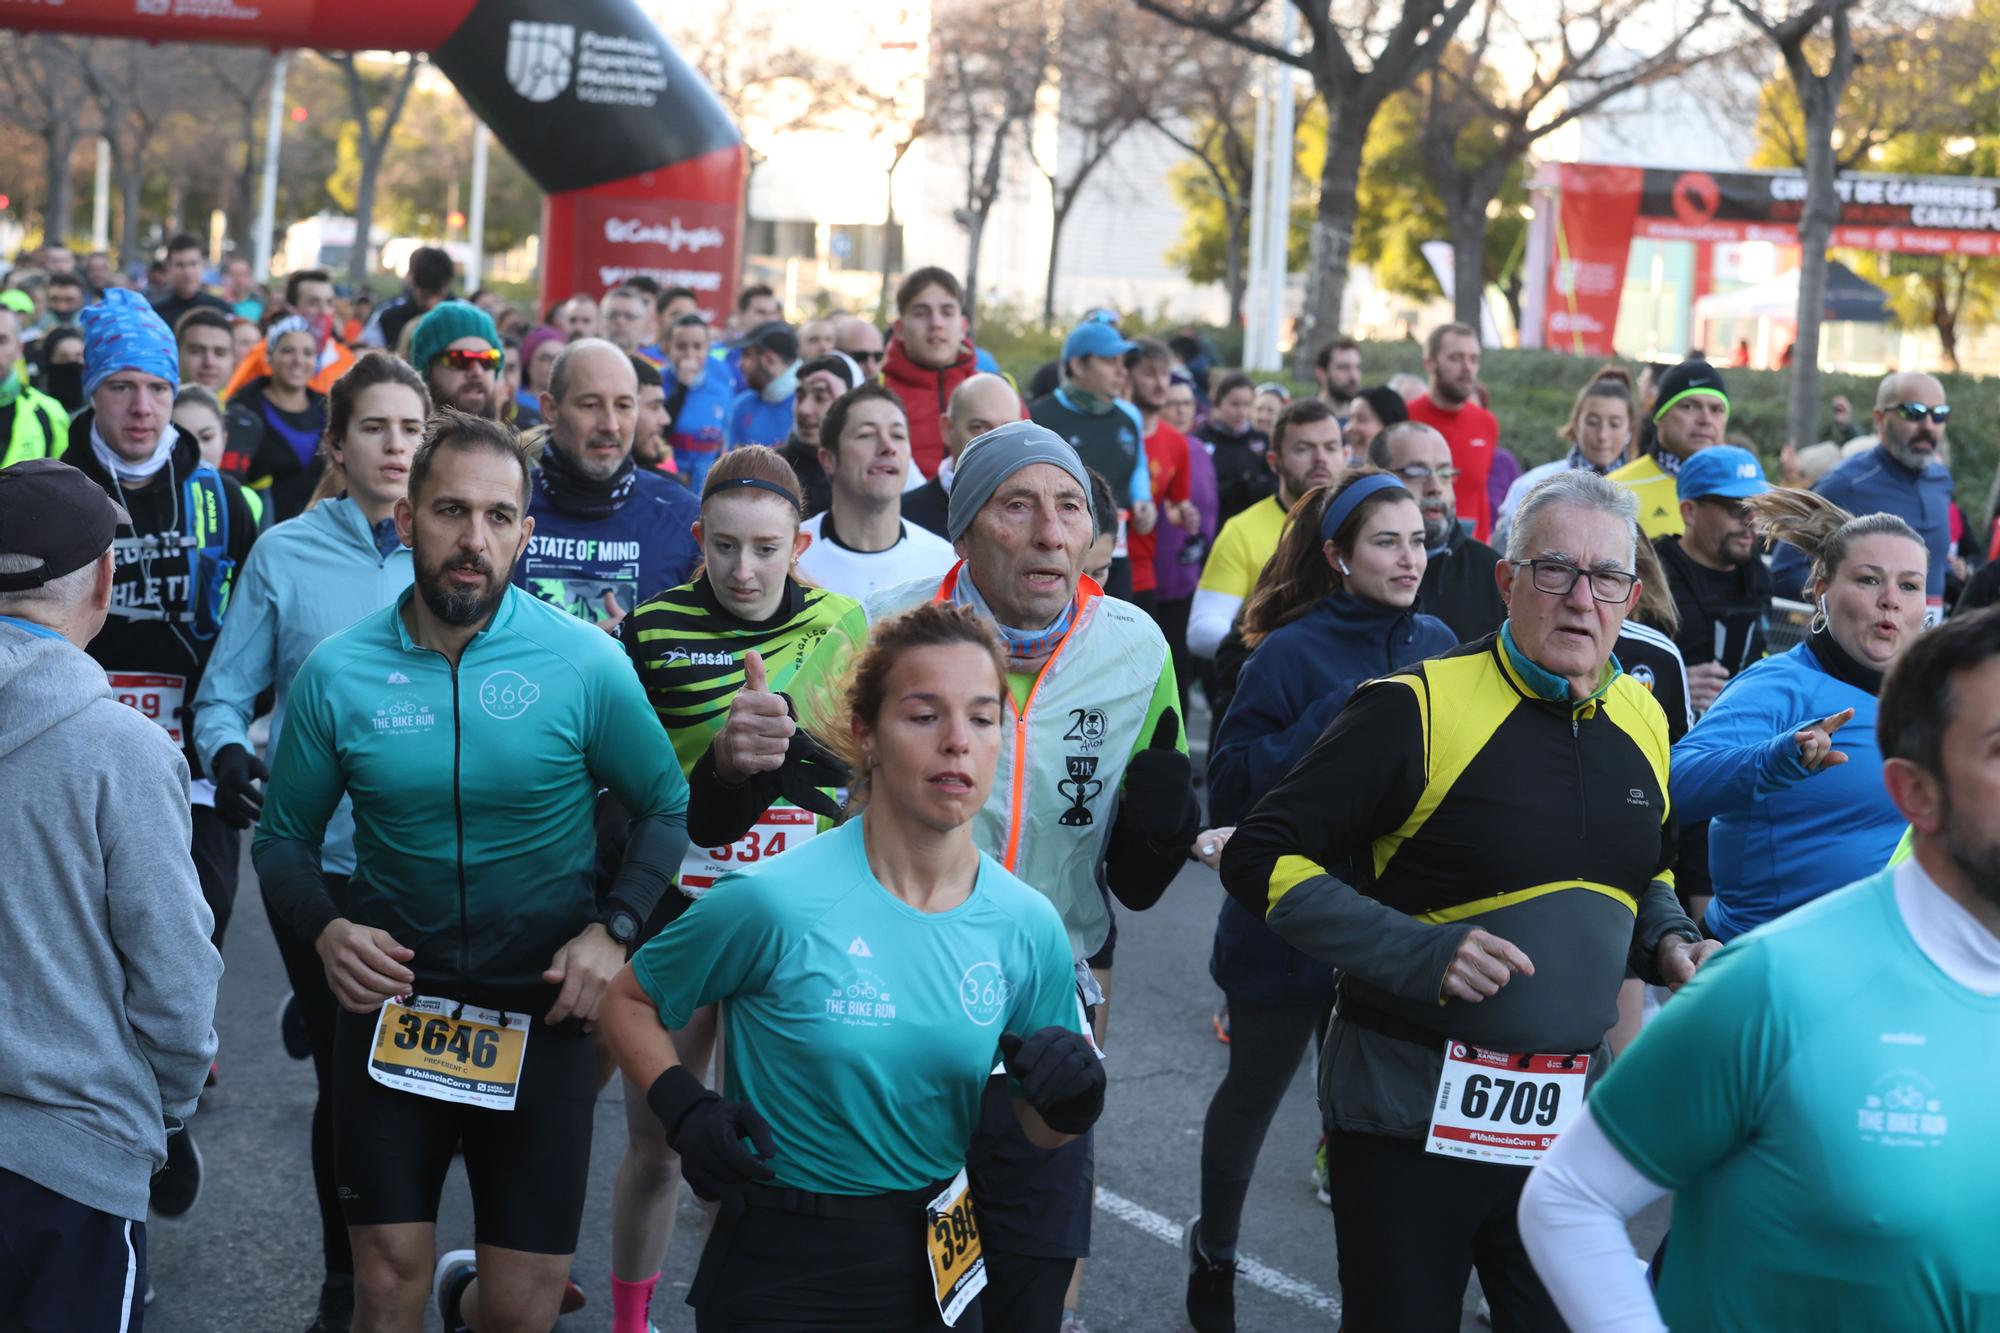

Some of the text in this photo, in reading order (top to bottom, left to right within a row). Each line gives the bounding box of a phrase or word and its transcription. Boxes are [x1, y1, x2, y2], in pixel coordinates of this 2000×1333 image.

[527, 535, 640, 562] STATE OF MIND
[691, 651, 734, 666] rasán
[372, 713, 435, 729] THE BIKE RUN
[825, 999, 897, 1019] THE BIKE RUN
[394, 1014, 499, 1069] 3646
[423, 1056, 464, 1073] PREFERENT
[404, 1068, 472, 1091] #ValènciaCorre
[1460, 1073, 1561, 1127] 6709
[1469, 1130, 1537, 1147] #ValènciaCorre
